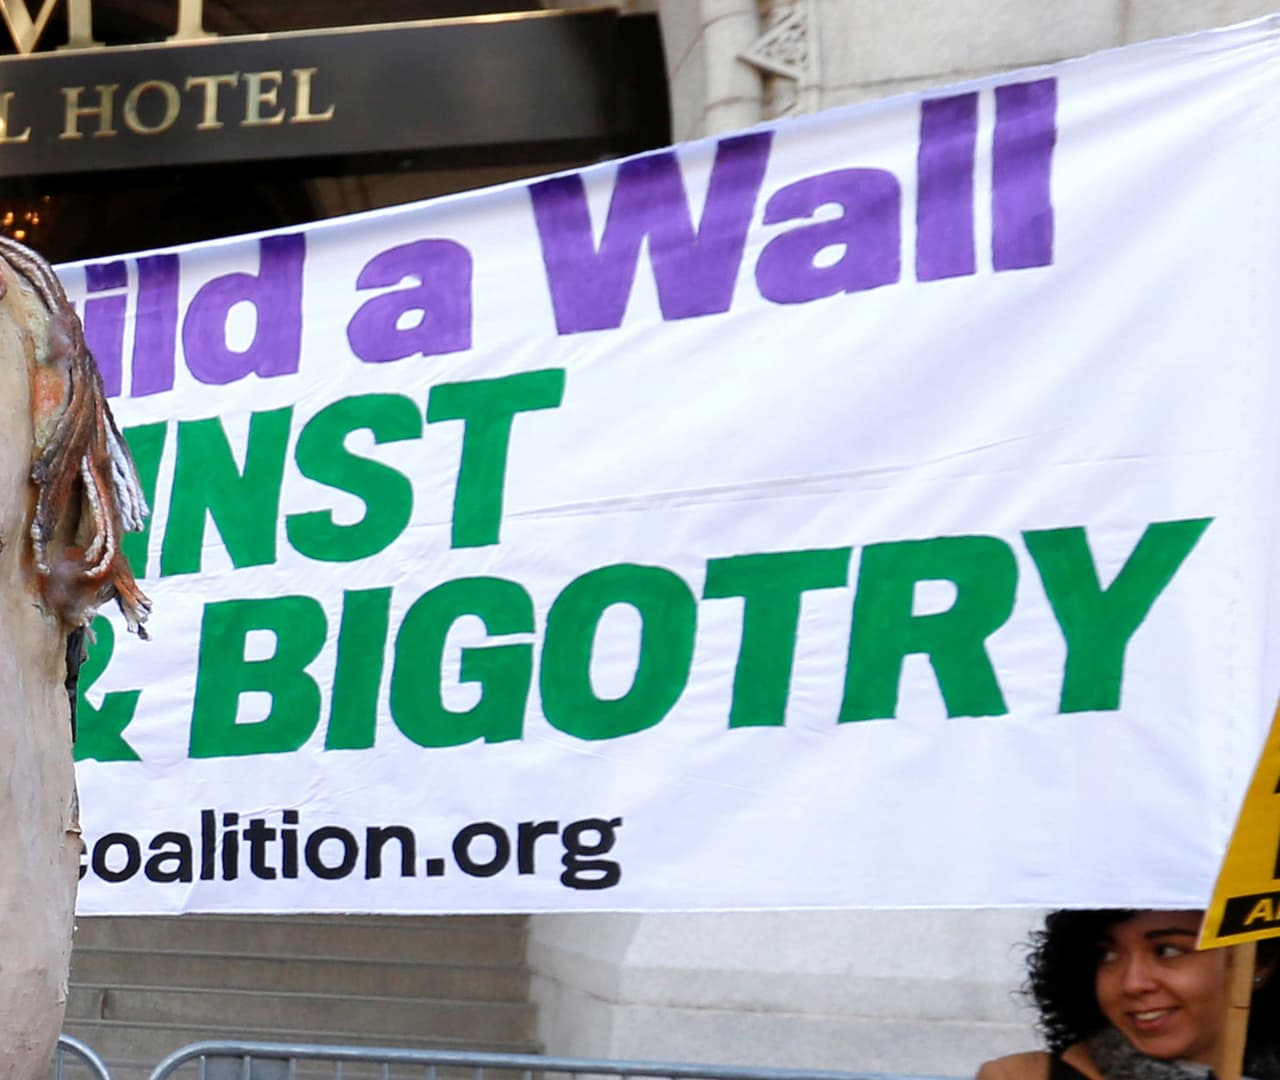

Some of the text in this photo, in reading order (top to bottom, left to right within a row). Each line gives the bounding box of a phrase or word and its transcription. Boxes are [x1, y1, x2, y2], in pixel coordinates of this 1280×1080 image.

[59, 67, 336, 140] HOTEL
[68, 77, 1058, 399] ild a Wall
[71, 508, 1215, 764] & BIGOTRY
